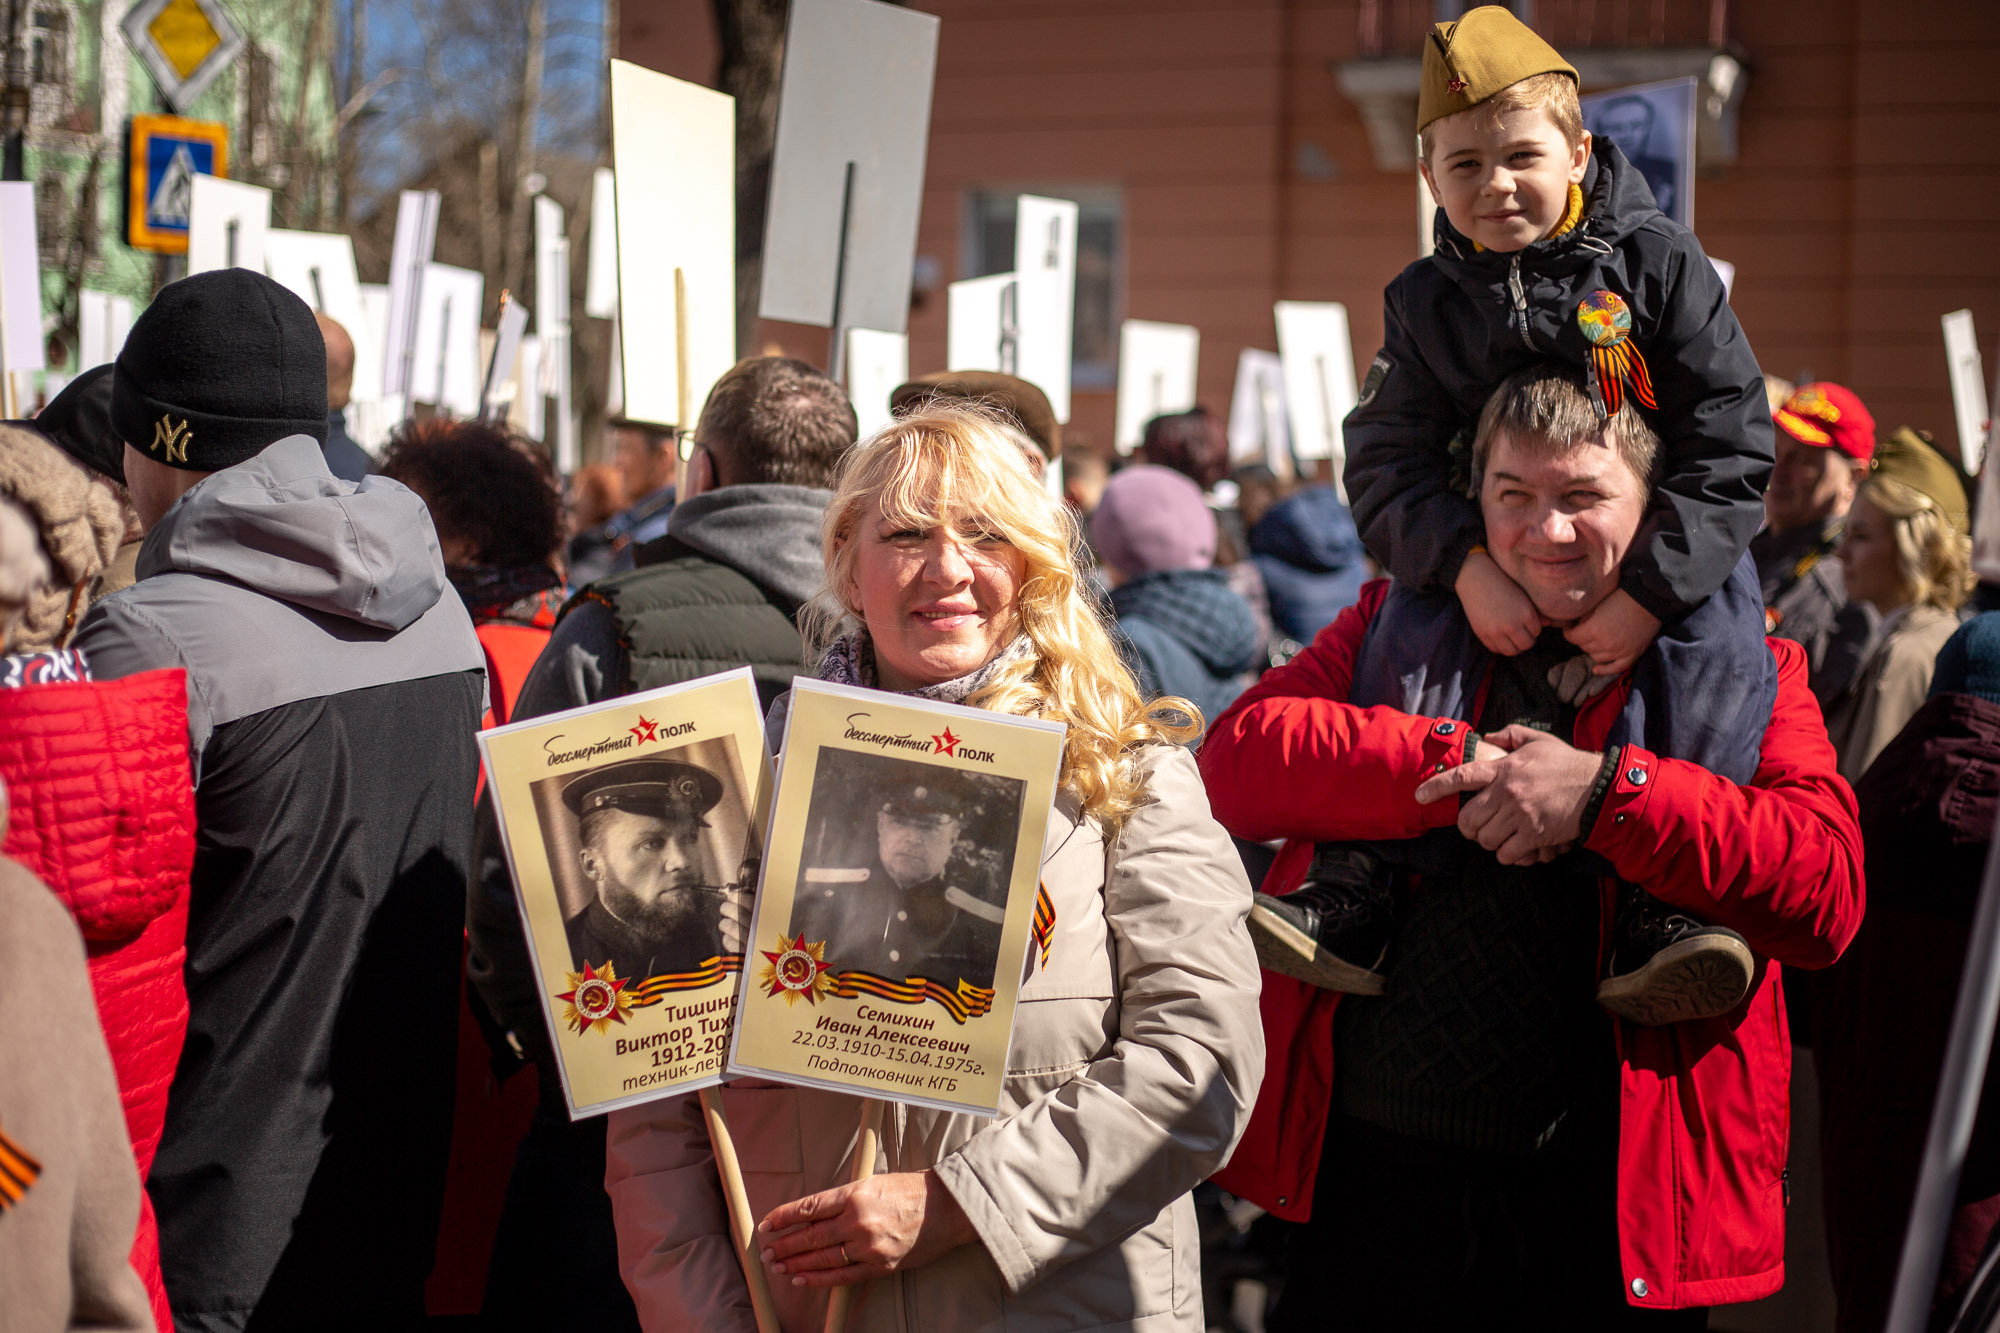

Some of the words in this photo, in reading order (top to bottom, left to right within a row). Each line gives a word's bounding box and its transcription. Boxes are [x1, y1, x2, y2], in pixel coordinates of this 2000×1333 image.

[150, 413, 193, 463] NY
[815, 1015, 862, 1036] Иван
[865, 1025, 970, 1055] Алексеевич
[856, 1005, 936, 1031] Семихин
[615, 1026, 693, 1056] Виктор
[791, 1030, 986, 1076] 22.03.1910-15.04.1975г.
[807, 1054, 925, 1087] Подполковник
[927, 1075, 959, 1092] КГБ
